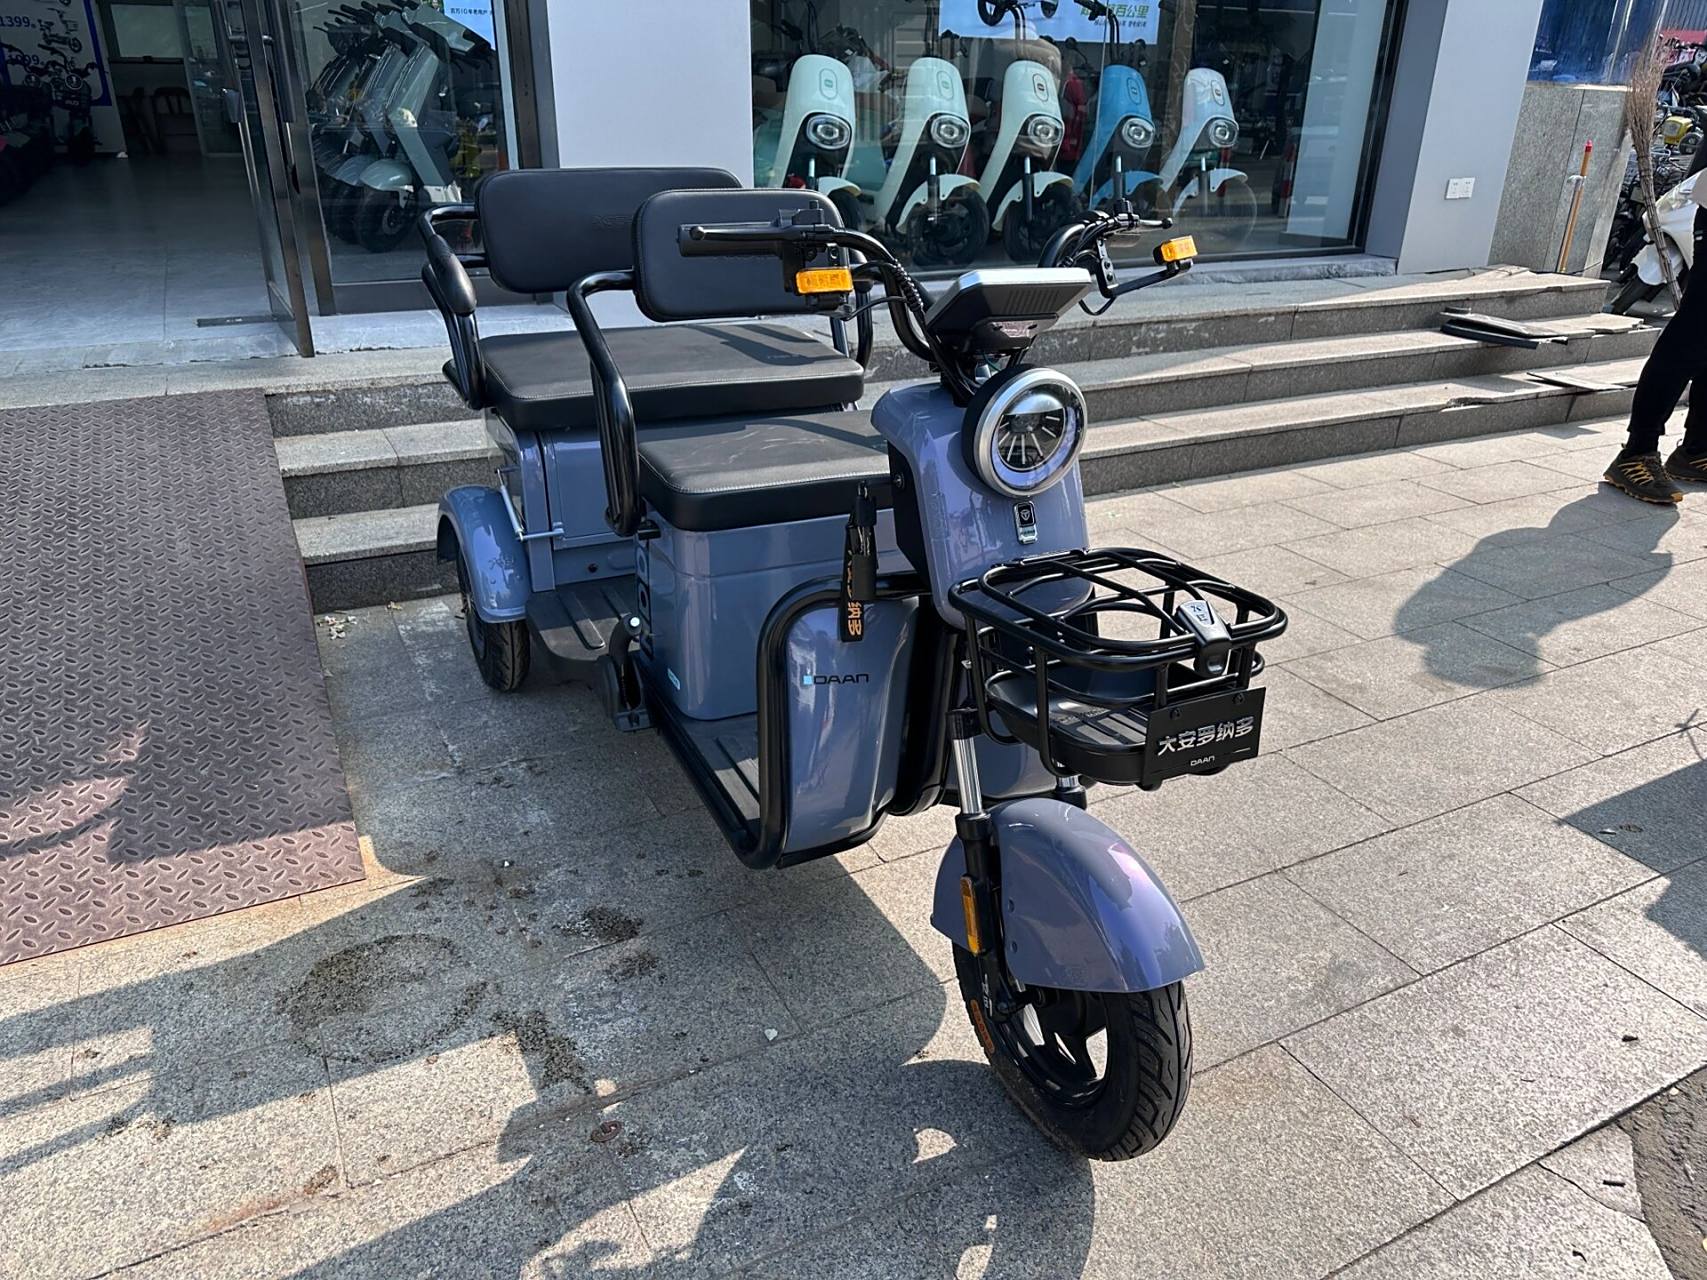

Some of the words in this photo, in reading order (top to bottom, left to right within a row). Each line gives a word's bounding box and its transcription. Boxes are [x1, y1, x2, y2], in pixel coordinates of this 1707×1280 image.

[1157, 716, 1254, 756] 大安罗纳多
